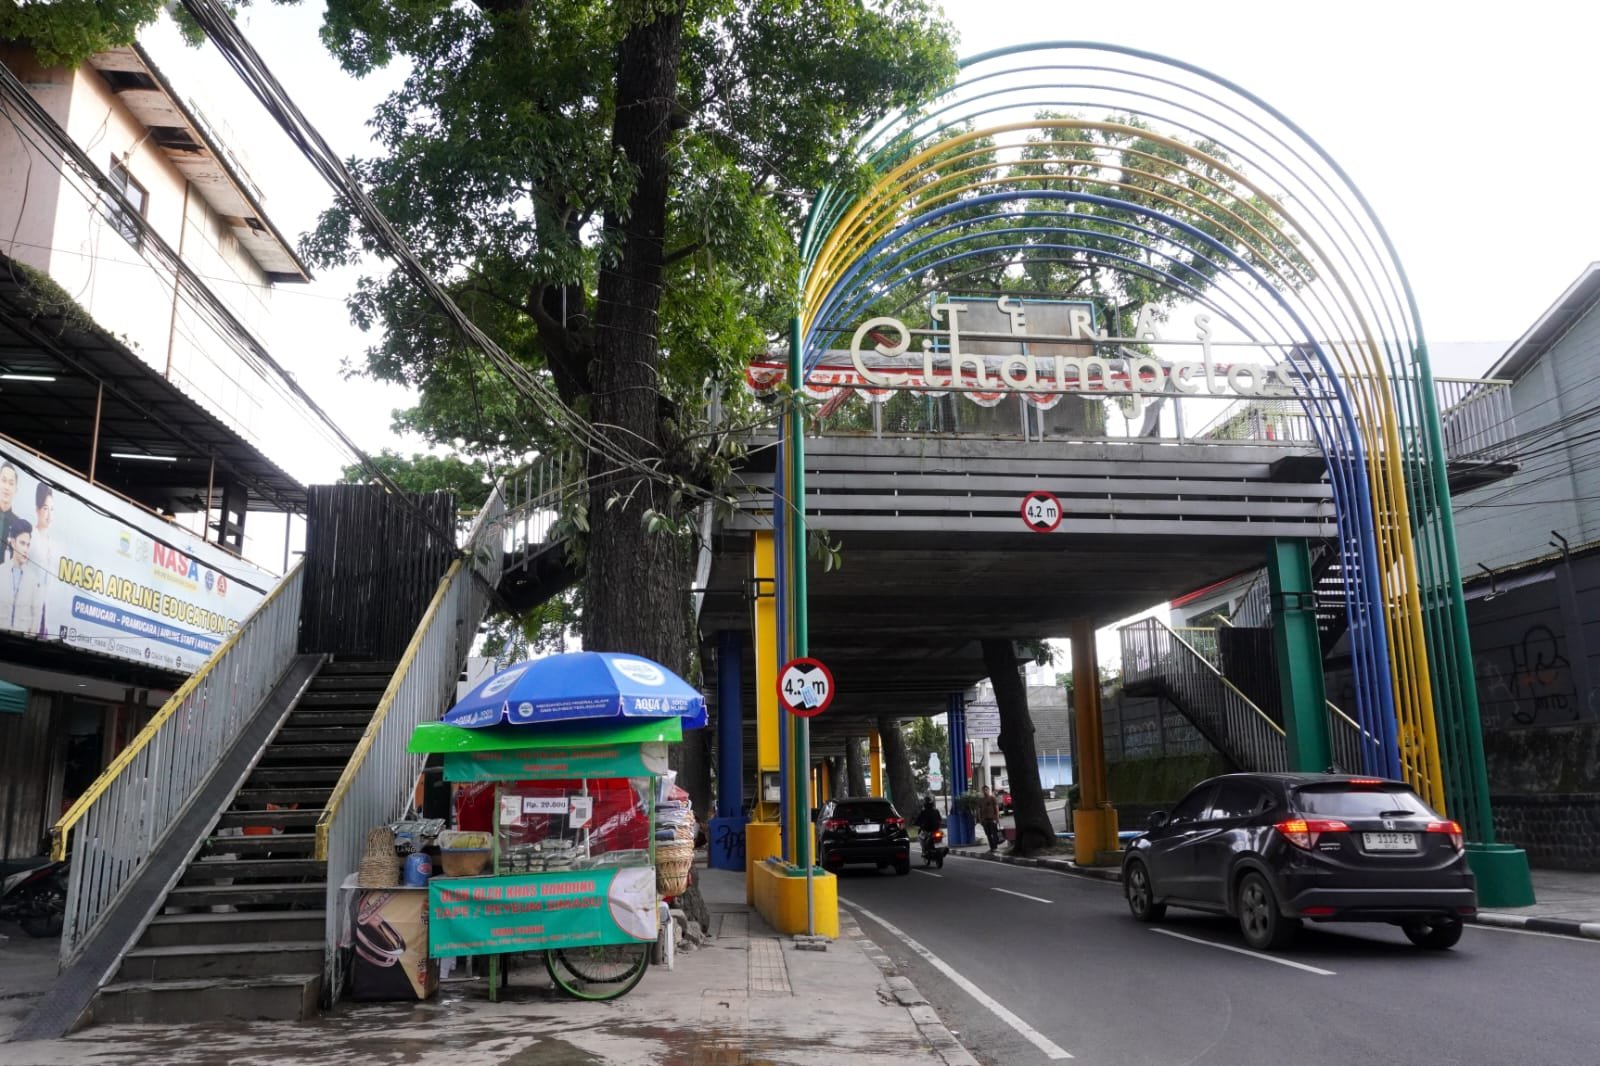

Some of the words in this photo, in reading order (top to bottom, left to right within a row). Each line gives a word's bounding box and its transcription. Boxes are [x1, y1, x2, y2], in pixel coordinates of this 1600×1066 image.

[931, 295, 1213, 342] TERAS
[851, 316, 1296, 418] Cihampelas
[1027, 505, 1042, 518] 4.2
[1046, 507, 1057, 518] m
[59, 556, 105, 595] NASA
[106, 574, 161, 614] AIRLINE
[162, 594, 226, 636] EDUCATION
[75, 601, 117, 624] PRAMUGARI
[635, 698, 660, 711] AQUA
[441, 888, 469, 902] OLEH
[473, 886, 502, 901] OLEH
[435, 906, 469, 919] TAPE
